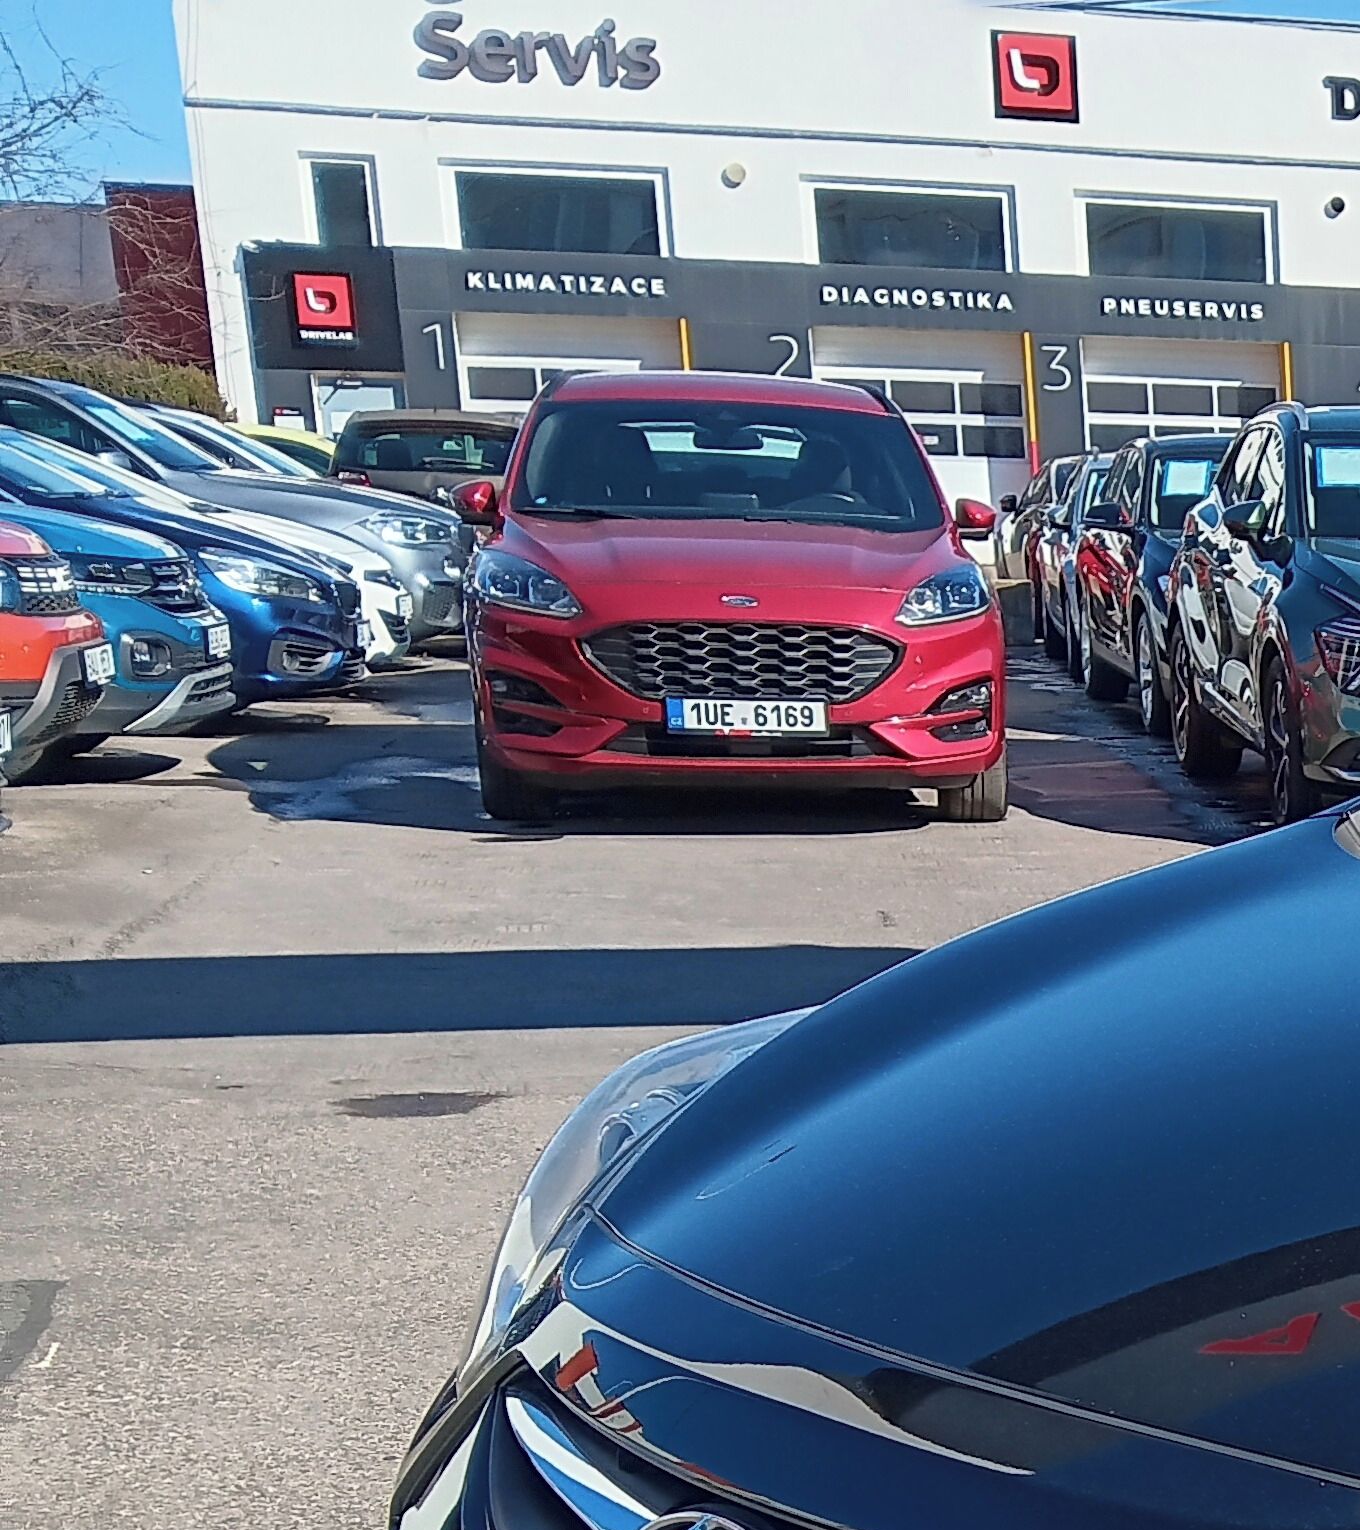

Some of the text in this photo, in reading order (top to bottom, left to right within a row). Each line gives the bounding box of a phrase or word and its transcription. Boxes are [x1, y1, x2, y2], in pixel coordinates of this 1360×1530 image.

[413, 11, 661, 90] Servis
[465, 271, 667, 297] KLIMATIZACE
[820, 285, 1015, 313] DIAGNOSTIKA
[1101, 297, 1266, 321] PNEUSERVIS
[422, 323, 447, 371] 1
[1040, 345, 1073, 391] 3
[690, 702, 735, 727] 1UE
[753, 704, 814, 728] 6169
